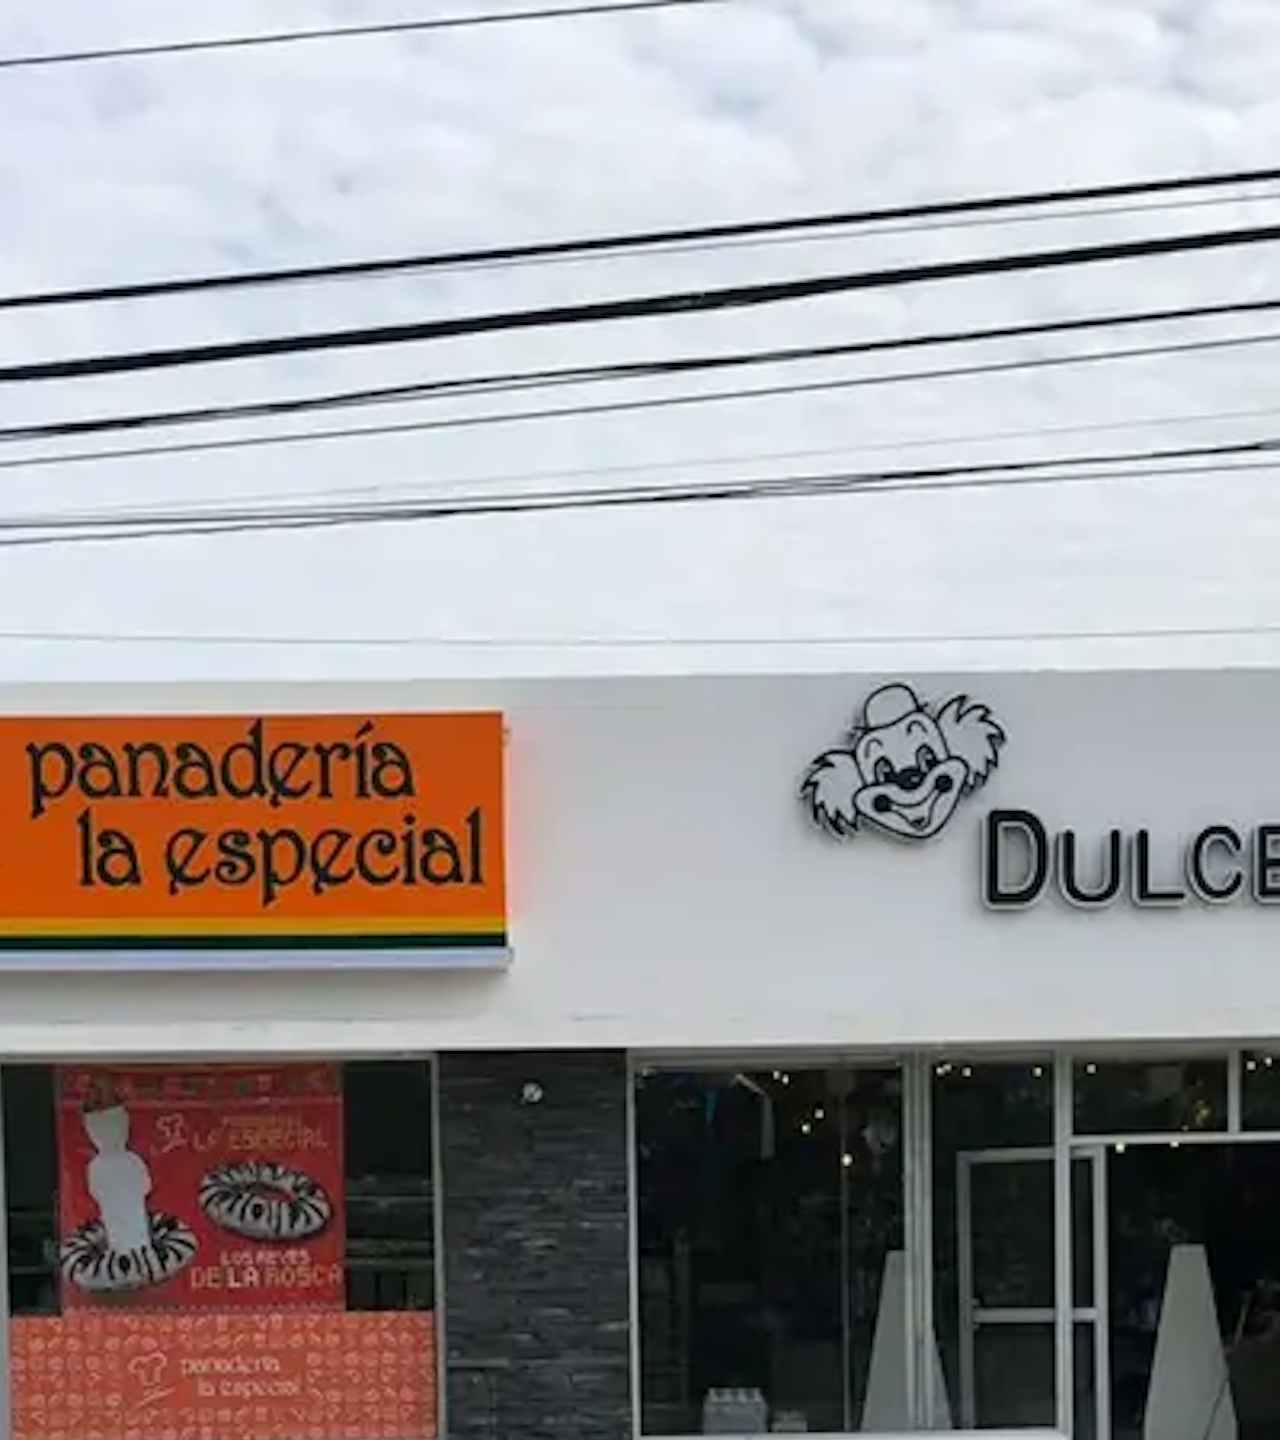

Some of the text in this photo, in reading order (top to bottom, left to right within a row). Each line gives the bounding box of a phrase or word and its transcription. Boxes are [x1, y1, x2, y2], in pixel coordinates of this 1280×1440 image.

[25, 717, 417, 820] panadería
[76, 806, 484, 907] la especial
[226, 1266, 260, 1288] LA
[264, 1264, 344, 1288] ROSCA
